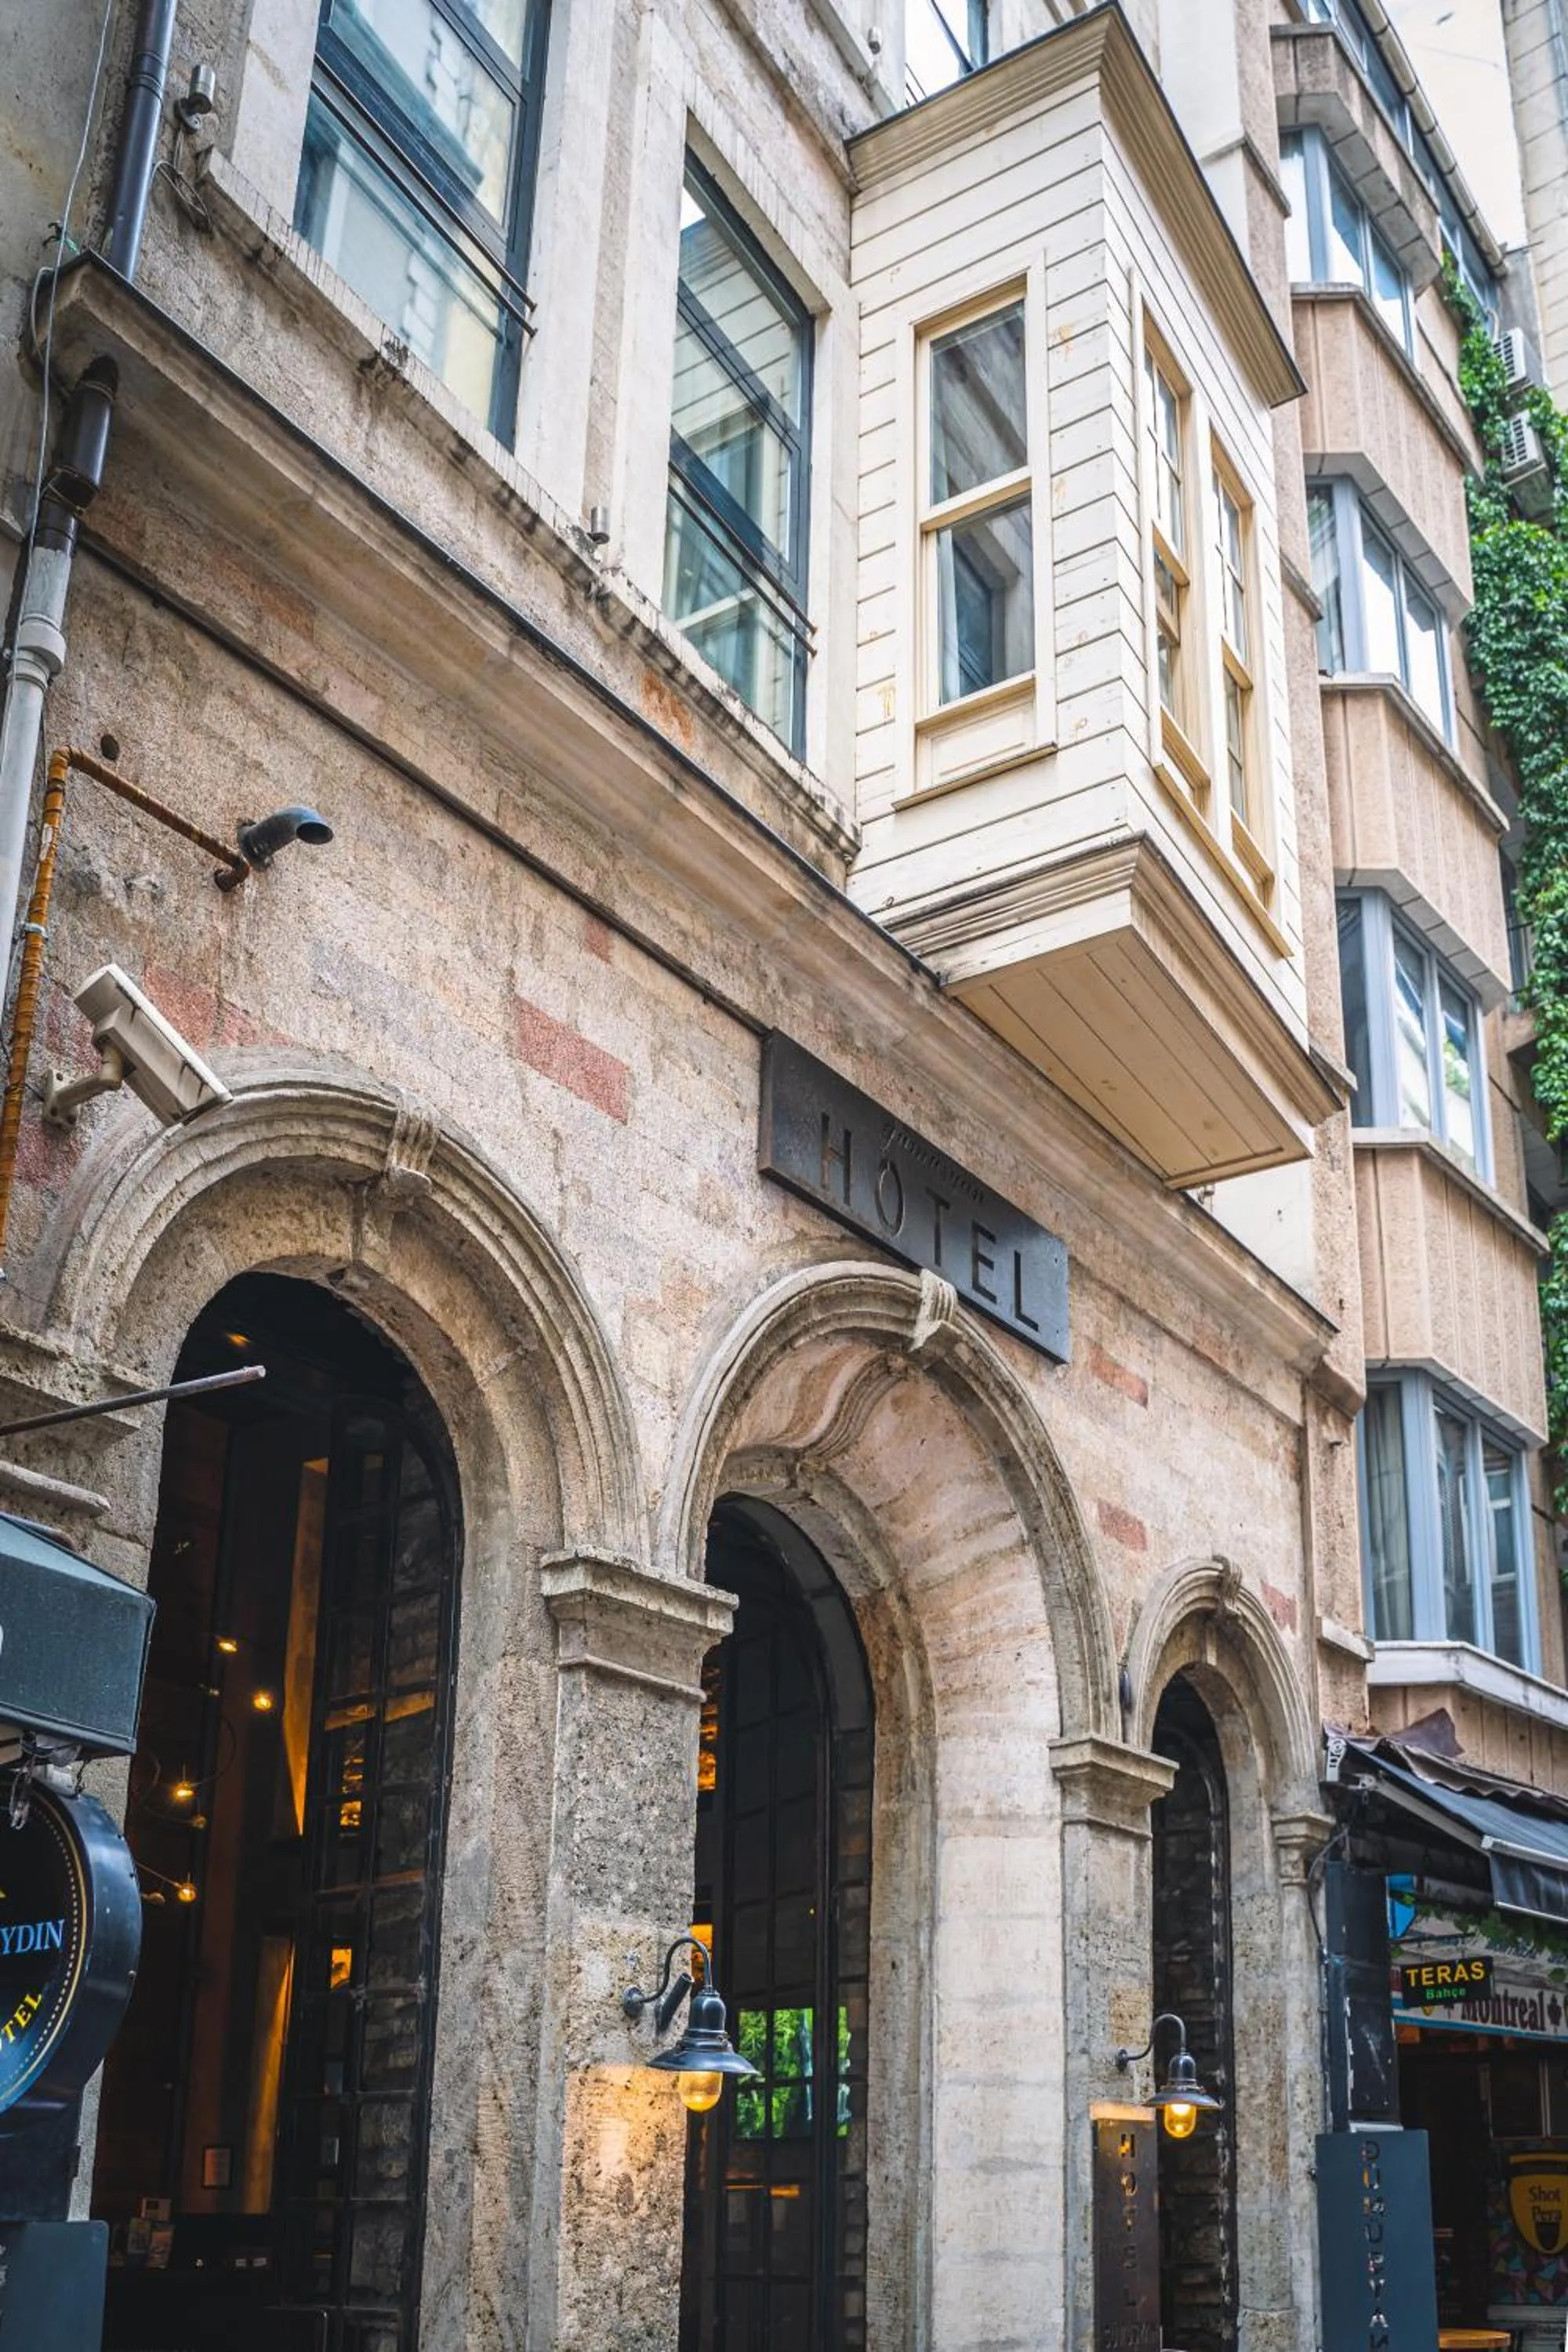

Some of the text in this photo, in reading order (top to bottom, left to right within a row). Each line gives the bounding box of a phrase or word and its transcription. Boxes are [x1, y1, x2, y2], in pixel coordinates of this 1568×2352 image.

[821, 1112, 1039, 1332] HOTEL
[1406, 1961, 1485, 1987] TERAS
[0, 1994, 42, 2050] TEL
